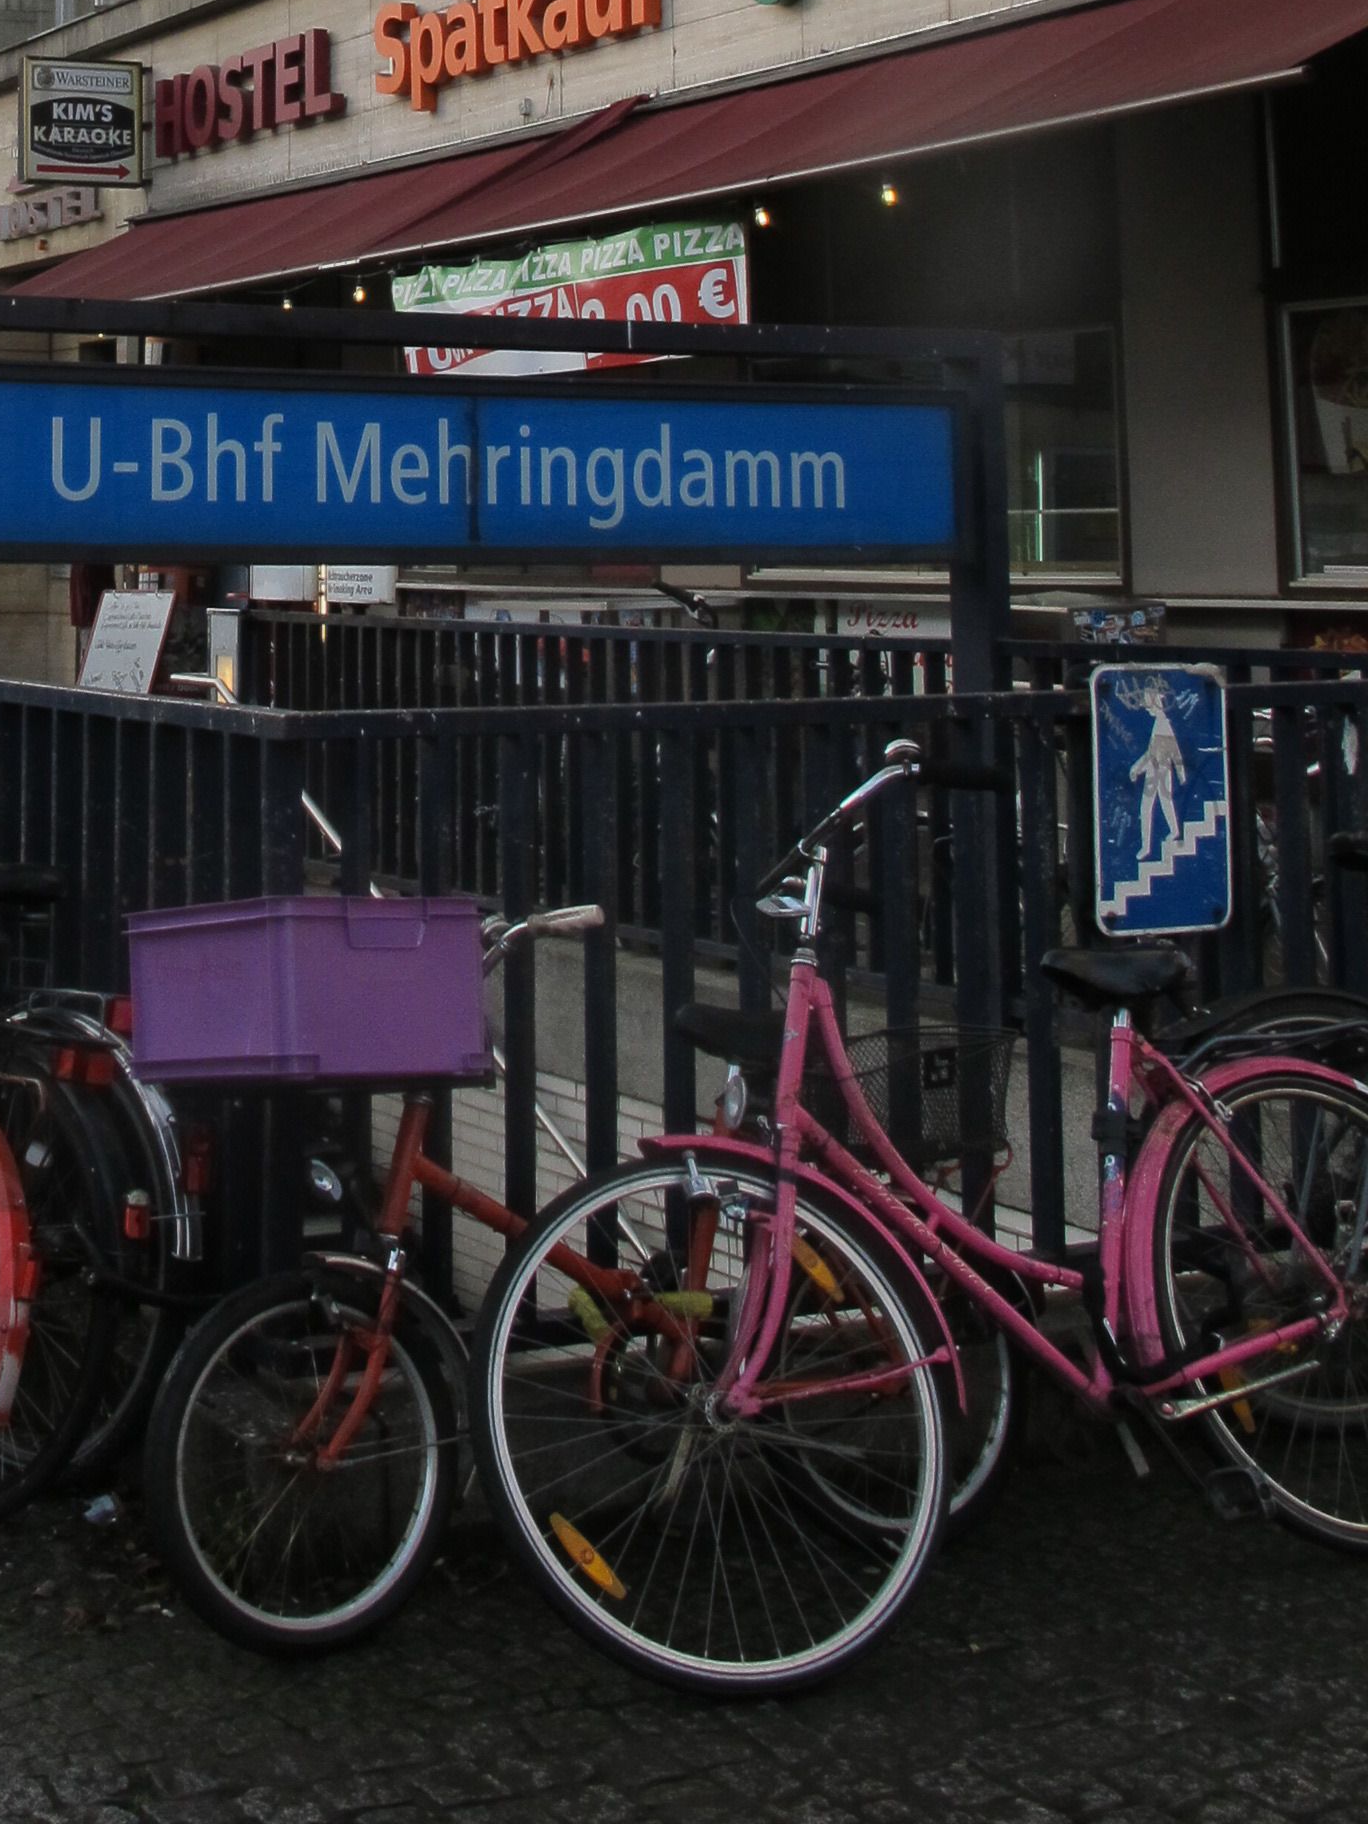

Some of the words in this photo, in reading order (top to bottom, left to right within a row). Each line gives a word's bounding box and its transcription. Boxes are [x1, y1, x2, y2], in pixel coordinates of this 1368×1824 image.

[52, 102, 114, 122] KIM'S
[155, 27, 348, 159] HOSTEL
[33, 126, 132, 145] KARAOKE
[581, 238, 645, 273] PIZZA
[653, 222, 745, 260] PIZZA
[49, 412, 284, 503] U-Bhf
[316, 416, 846, 531] Mehringdamm
[847, 601, 918, 629] Pizza
